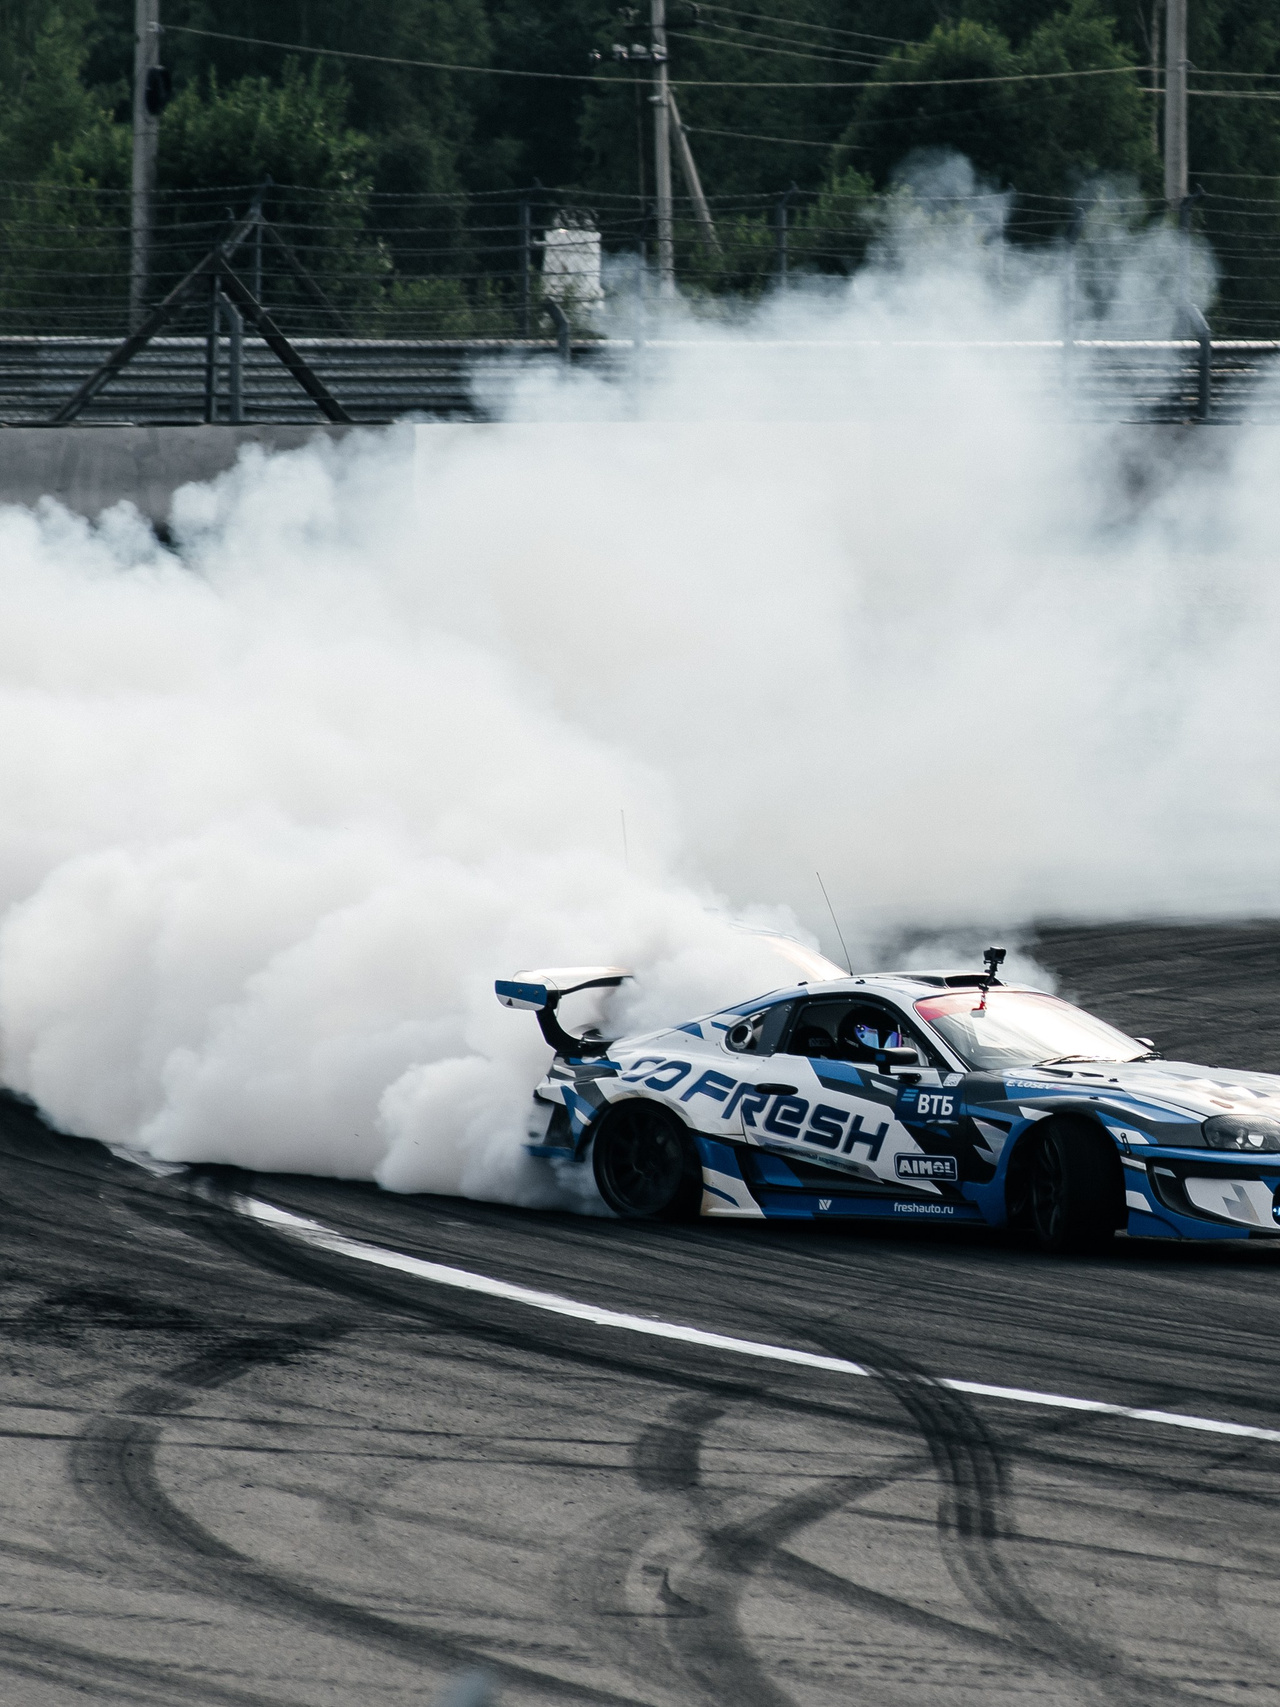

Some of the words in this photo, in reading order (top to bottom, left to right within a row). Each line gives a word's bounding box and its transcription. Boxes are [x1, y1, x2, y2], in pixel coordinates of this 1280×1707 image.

[917, 1093, 954, 1116] ВТБ
[901, 1159, 955, 1175] AIMOL
[894, 1202, 954, 1214] freshauto.ru
